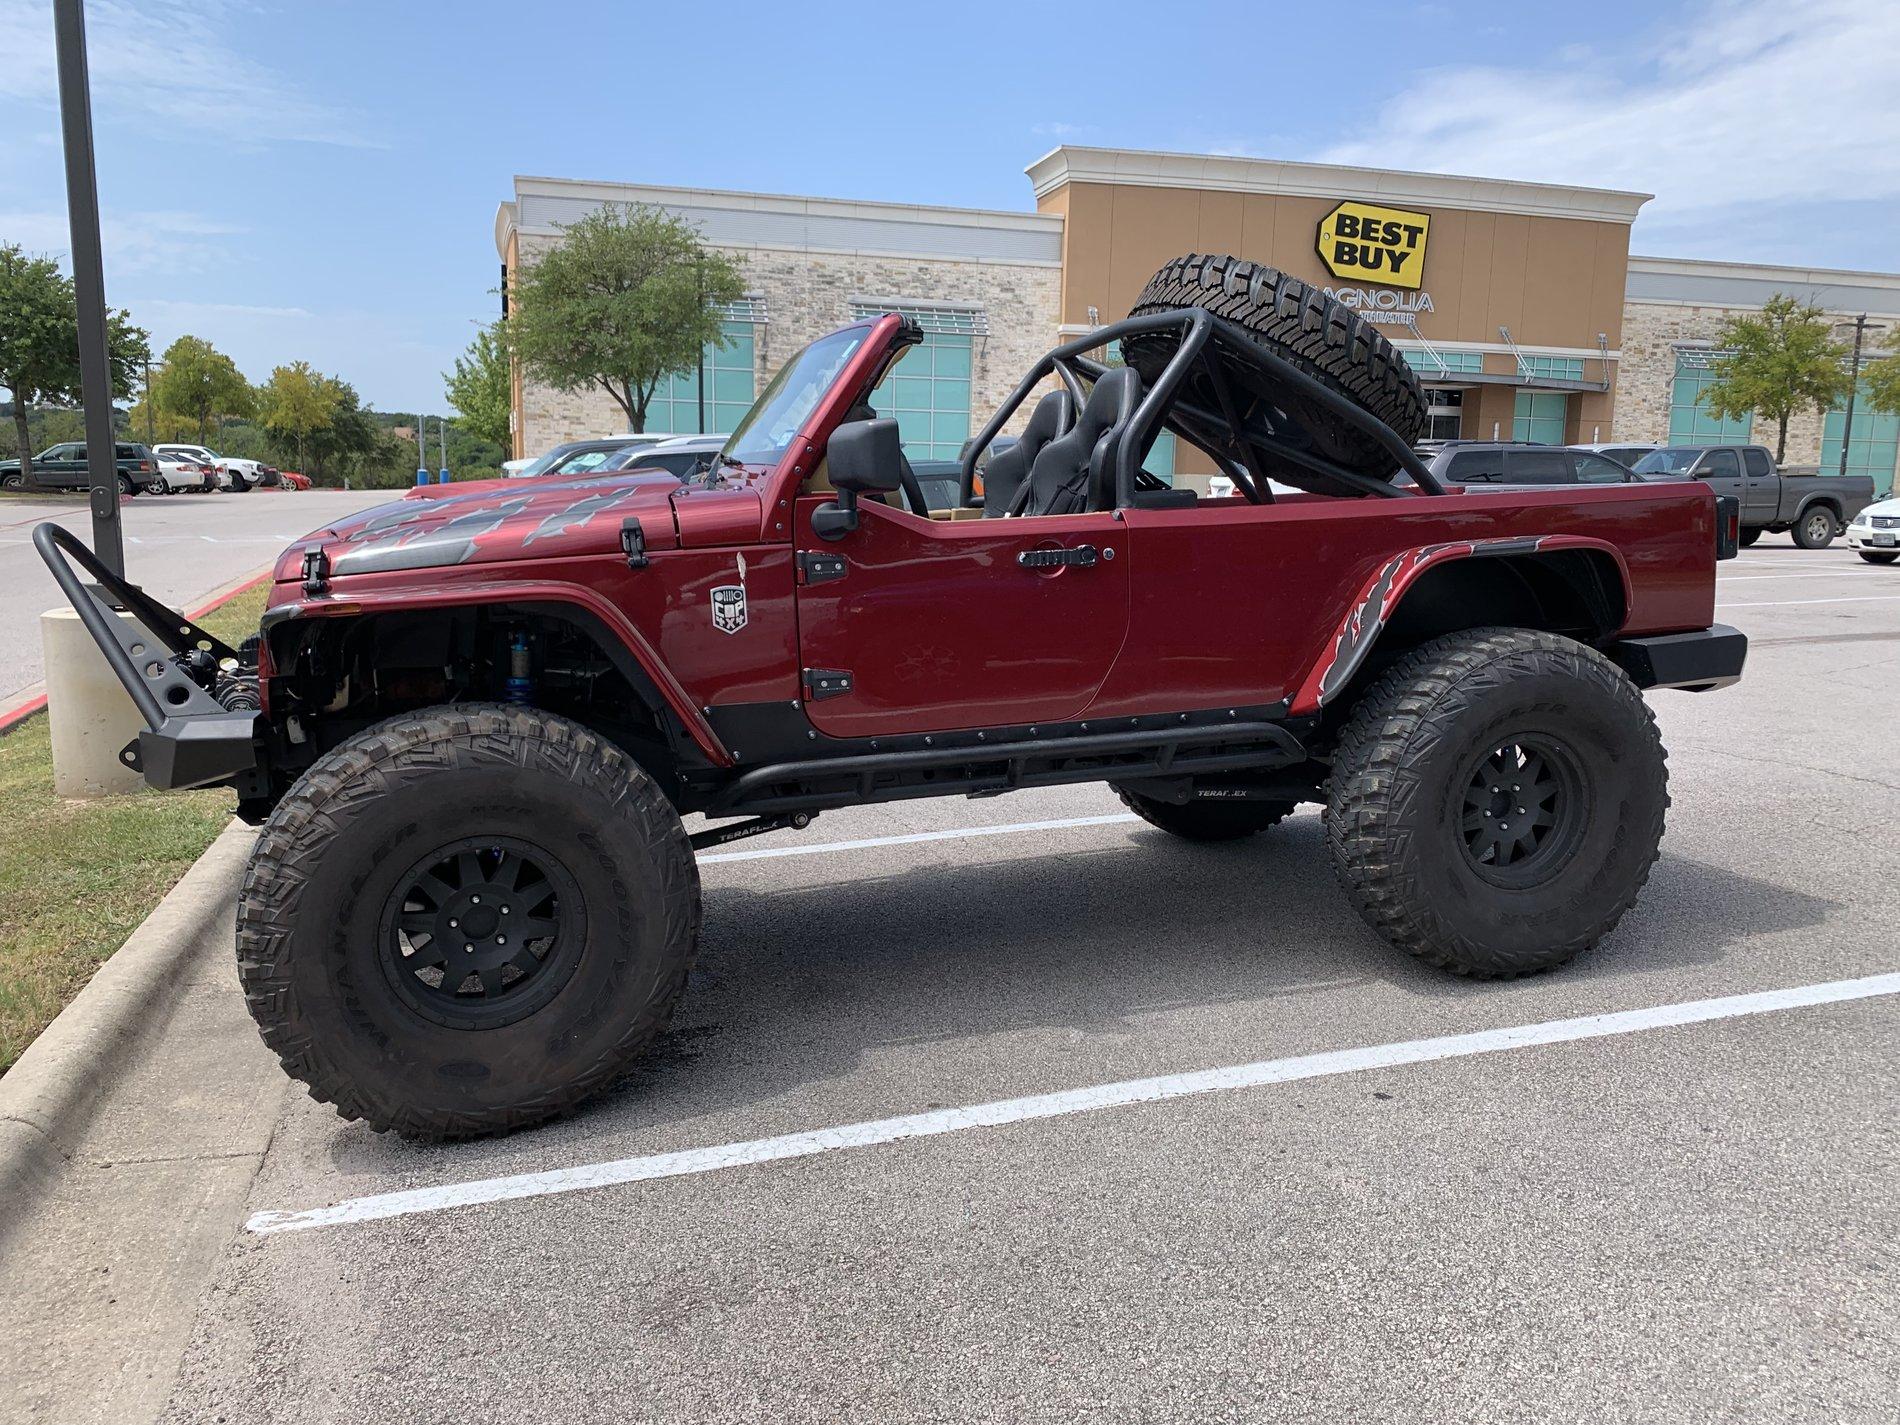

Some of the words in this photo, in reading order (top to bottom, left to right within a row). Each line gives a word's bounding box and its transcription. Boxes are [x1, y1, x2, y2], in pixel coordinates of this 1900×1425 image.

[1335, 213, 1424, 249] BEST
[1333, 241, 1411, 273] BUY
[1309, 284, 1435, 313] AGNOLIA
